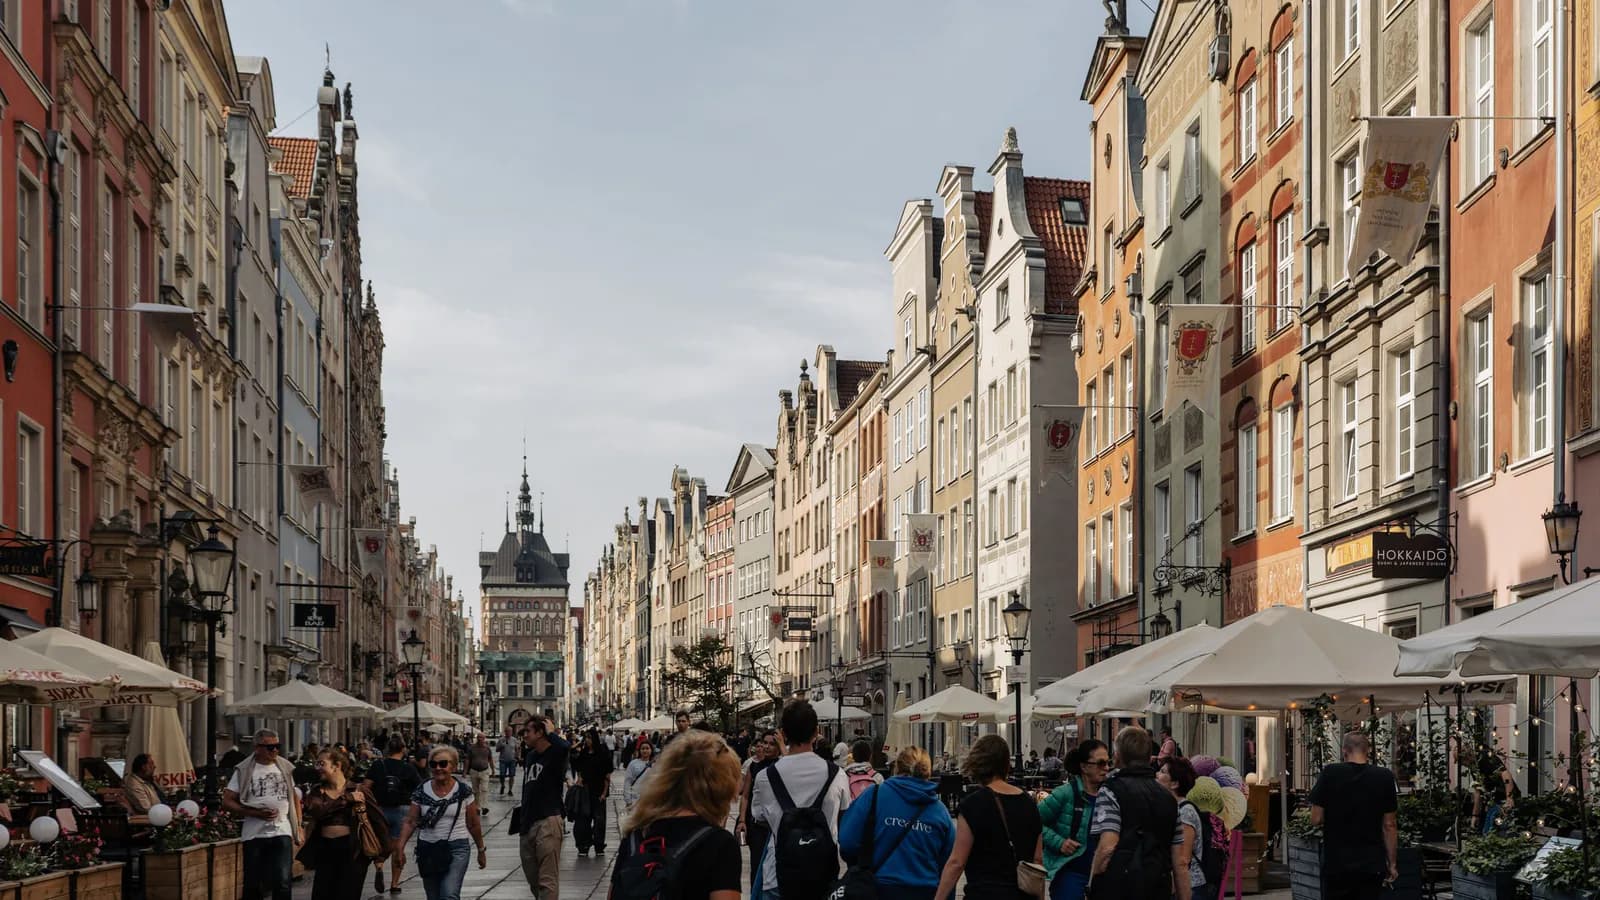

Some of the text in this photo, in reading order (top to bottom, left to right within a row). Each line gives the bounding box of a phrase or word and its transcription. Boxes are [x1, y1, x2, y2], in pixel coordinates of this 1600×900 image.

[1377, 548, 1447, 561] HOKKAIDŌ
[1438, 681, 1505, 695] PEPSI
[525, 762, 544, 785] AP
